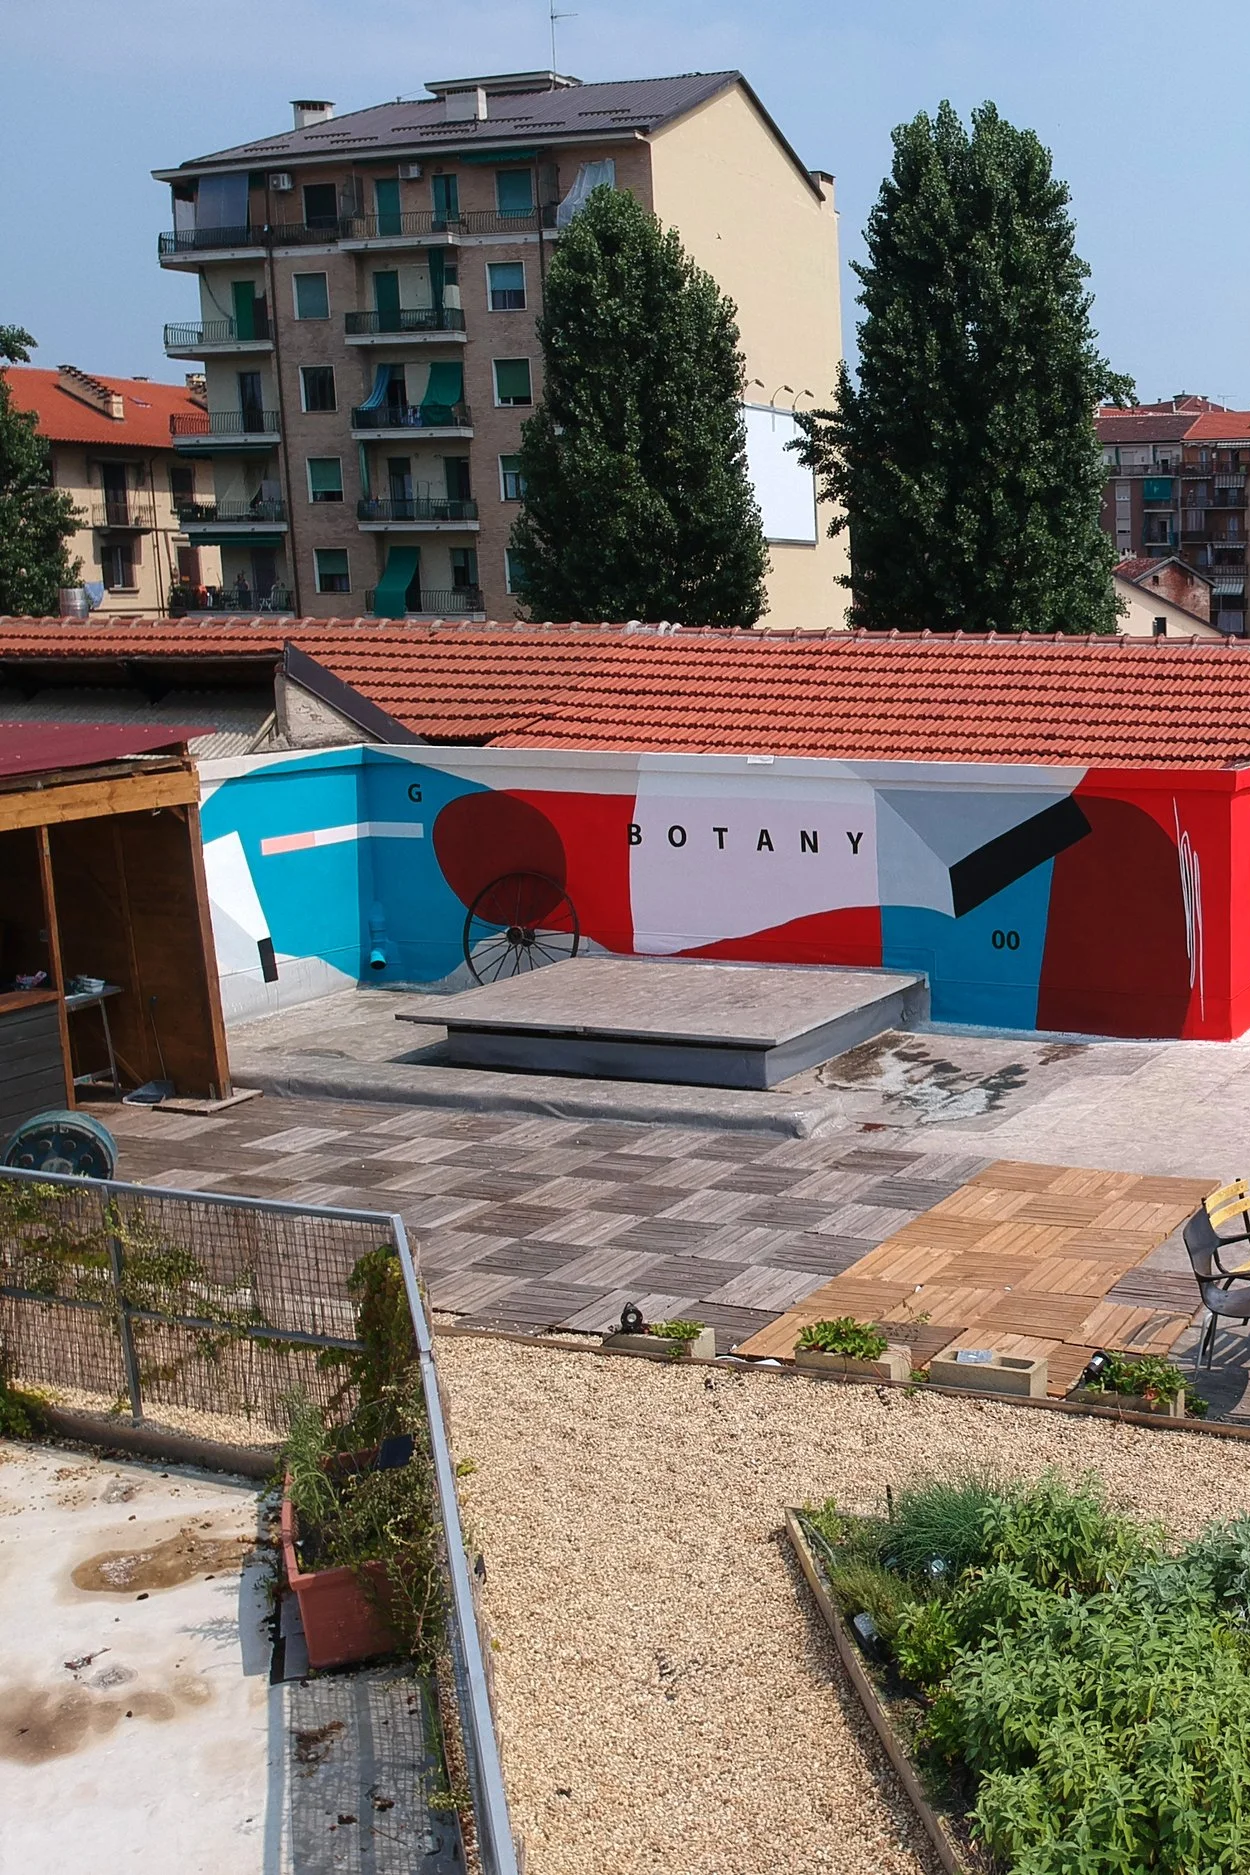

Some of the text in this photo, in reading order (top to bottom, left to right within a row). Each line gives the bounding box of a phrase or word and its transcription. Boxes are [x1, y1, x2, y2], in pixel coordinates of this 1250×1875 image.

[407, 783, 423, 803] G
[627, 823, 864, 854] BOTANY
[991, 929, 1021, 951] 00
